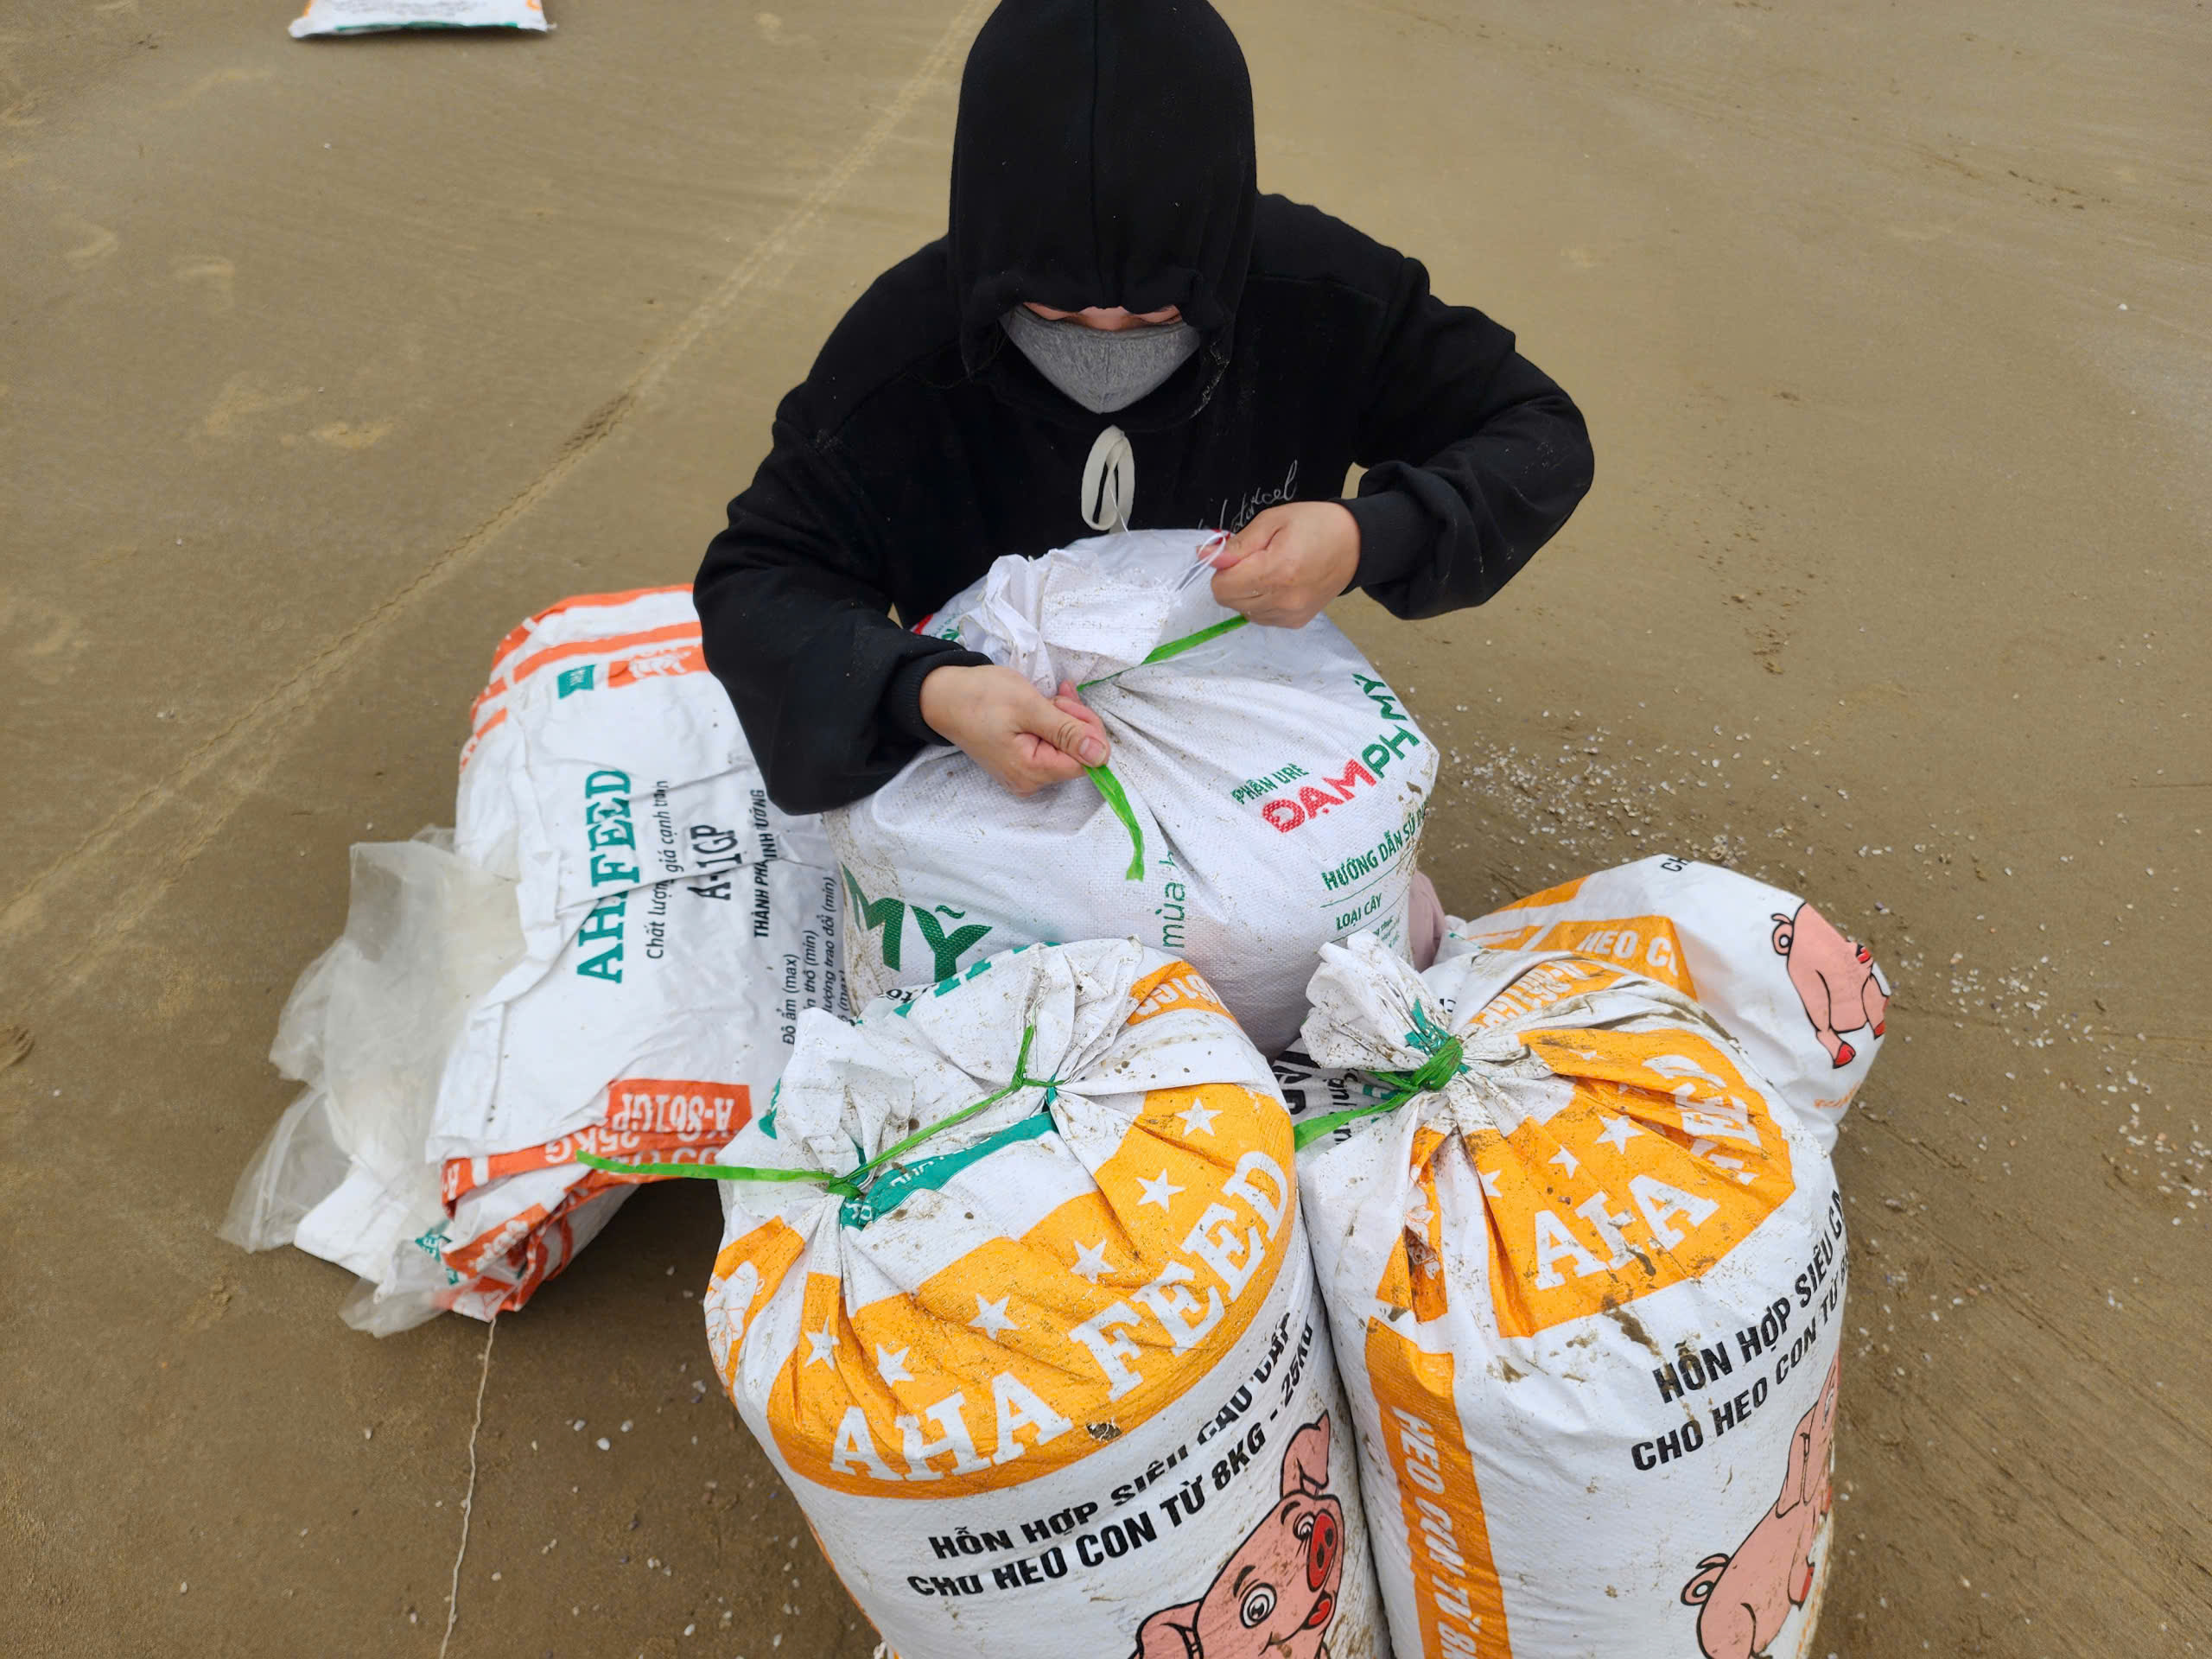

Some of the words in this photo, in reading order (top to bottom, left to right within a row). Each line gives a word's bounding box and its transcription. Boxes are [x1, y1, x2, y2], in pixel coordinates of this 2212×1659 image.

[584, 769, 640, 887] FEED
[653, 810, 677, 844] cạnh
[658, 849, 684, 873] giá
[1321, 849, 1379, 891] HƯỚNG
[1377, 830, 1404, 862] DẪN
[749, 888, 771, 938] THÀNH
[823, 876, 837, 912] (min)
[1154, 882, 1185, 948] mùa
[1335, 906, 1362, 931] LOẠI
[1364, 892, 1382, 916] CÂY
[576, 890, 629, 983] AH
[644, 921, 664, 959] Chất
[802, 930, 819, 966] (min)
[816, 914, 835, 937] đổi
[781, 953, 800, 993] (max)
[823, 940, 835, 968] trao
[802, 969, 816, 992] thô
[775, 998, 797, 1020] ẩm
[1533, 1173, 1721, 1292] AHA
[830, 1371, 1073, 1483] AHA
[1069, 1150, 1290, 1402] FEED
[1652, 1339, 1733, 1404] HỖN
[1734, 1296, 1792, 1364] HỢP
[1794, 1229, 1834, 1308] SIÊU
[1631, 1420, 1704, 1471] CHO
[1712, 1376, 1768, 1438] HEO
[1776, 1314, 1817, 1386] CON
[1391, 1405, 1446, 1495] HEO
[928, 1525, 1014, 1560] HỖN
[1020, 1502, 1098, 1544] HỢP
[992, 1546, 1069, 1591] HEO
[1076, 1510, 1159, 1568] CON
[1159, 1474, 1206, 1529] TỪ
[1211, 1421, 1267, 1491] 8KG
